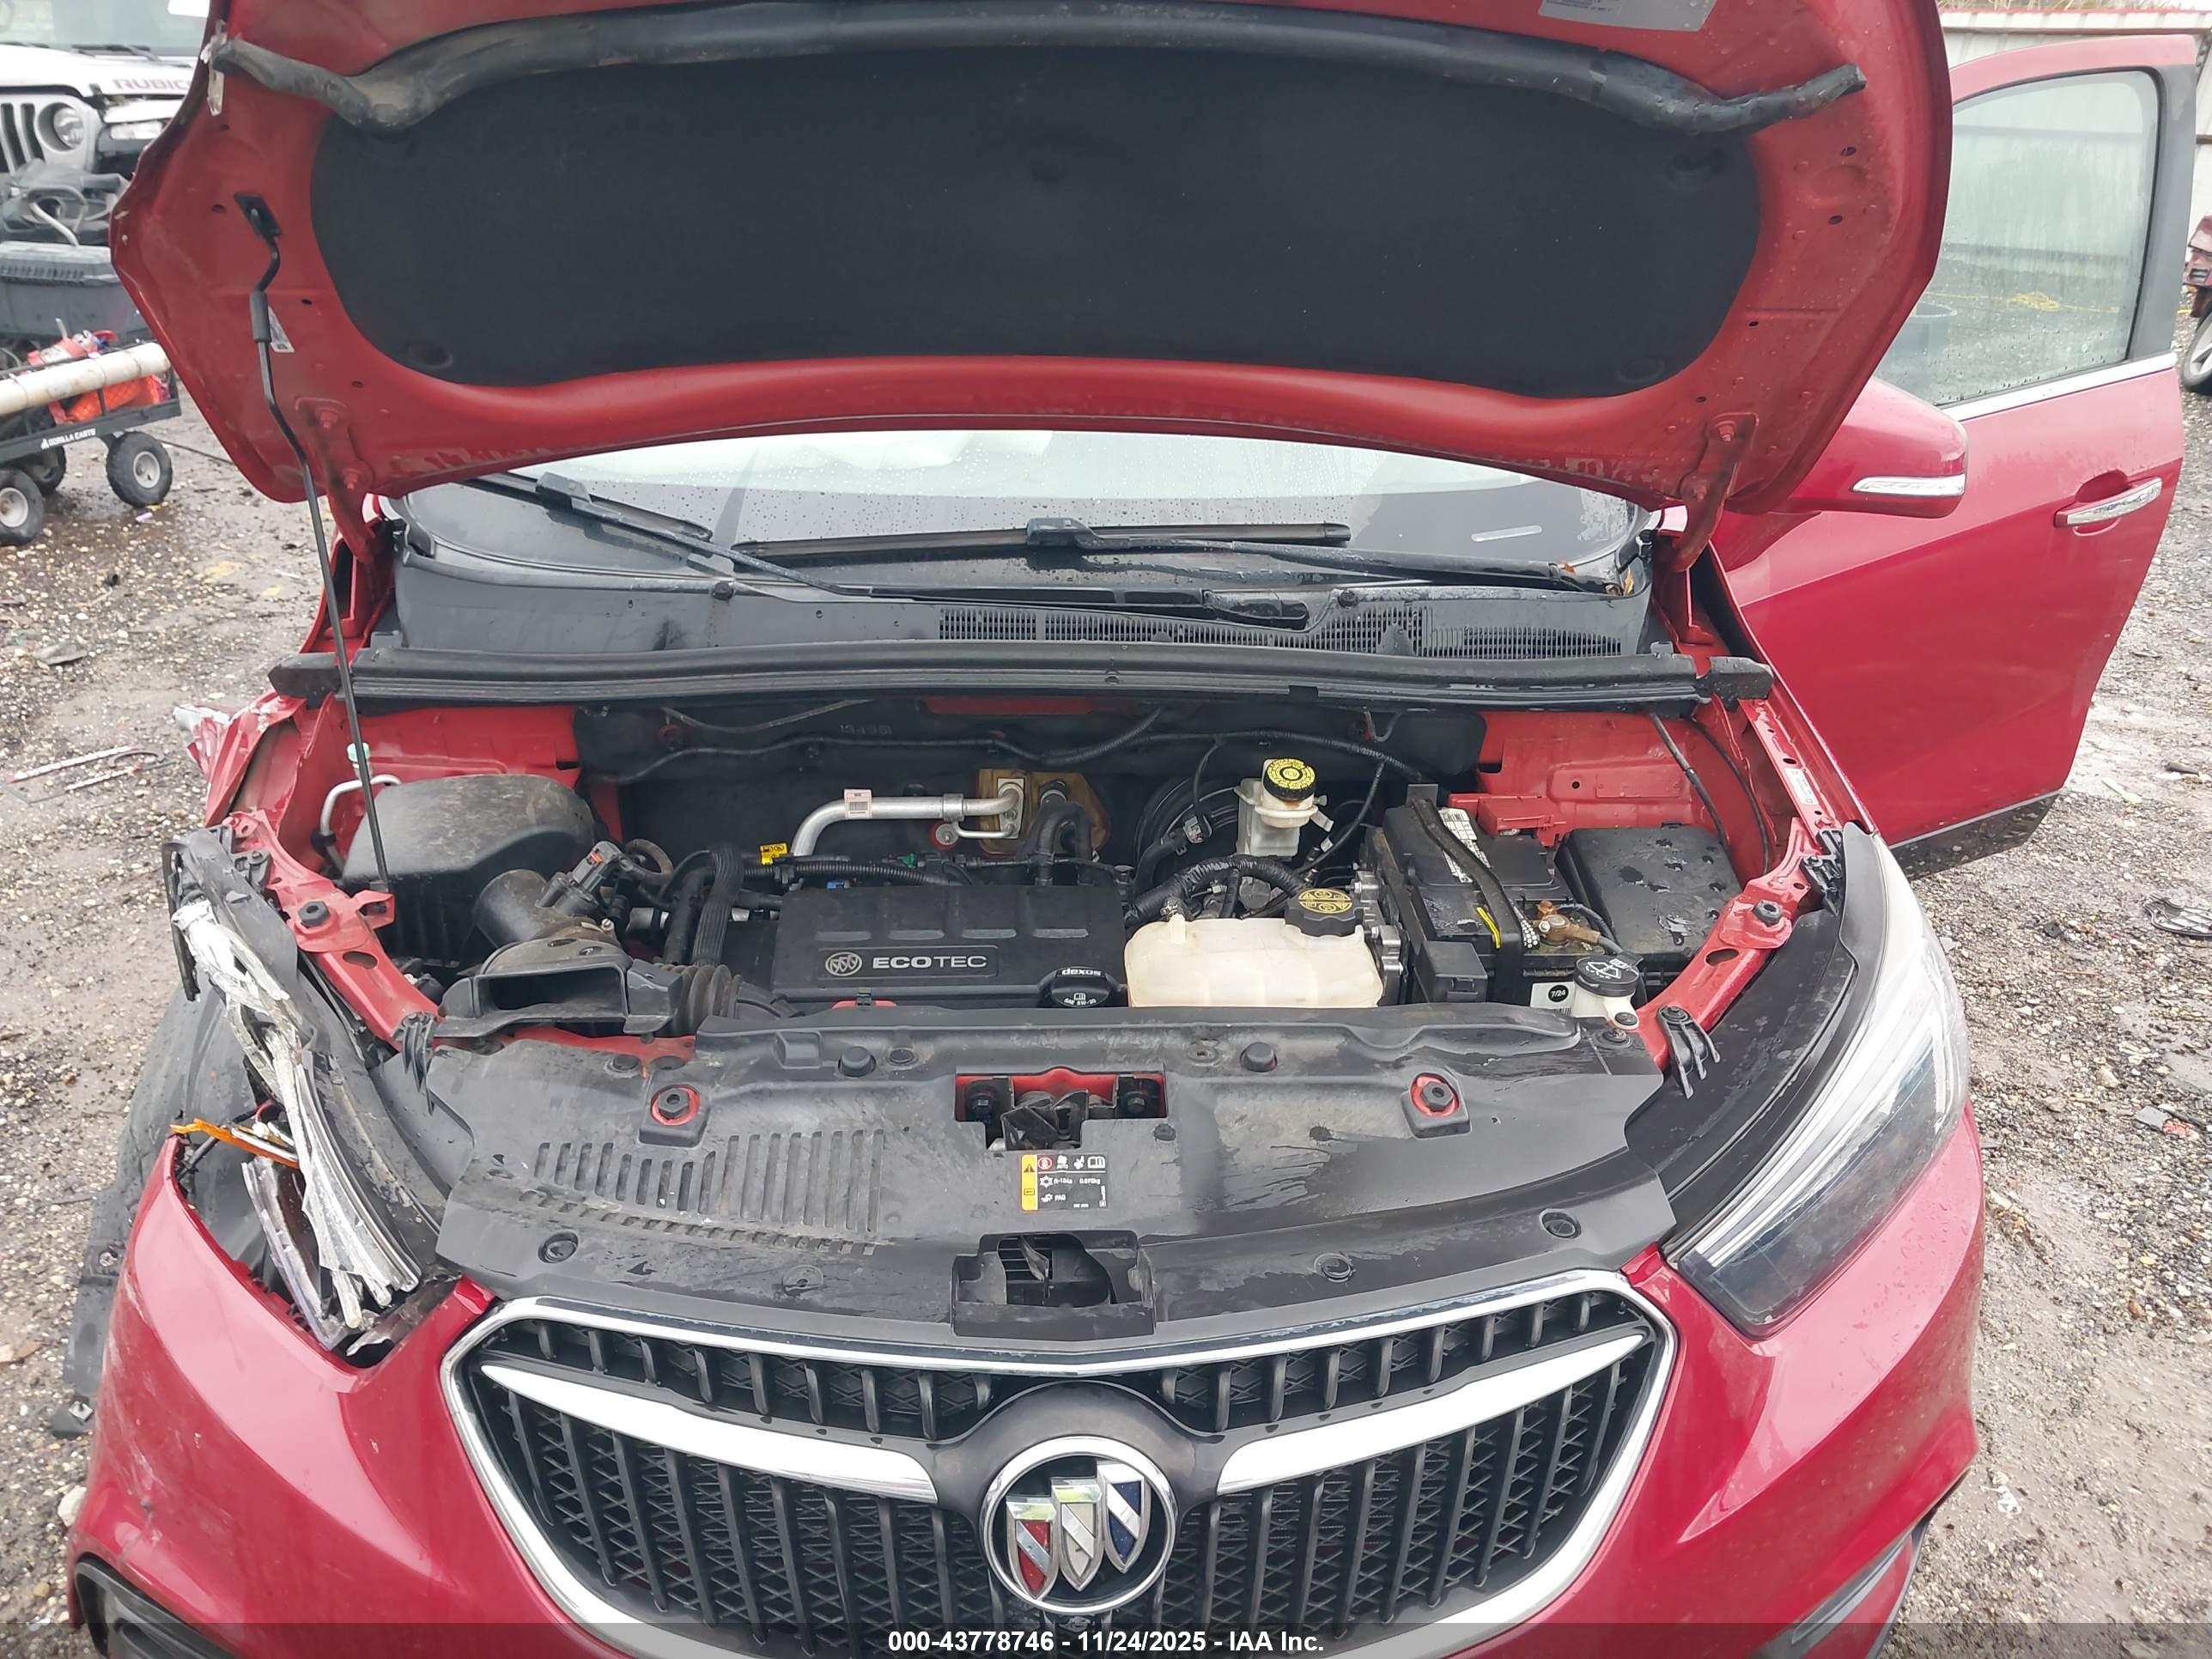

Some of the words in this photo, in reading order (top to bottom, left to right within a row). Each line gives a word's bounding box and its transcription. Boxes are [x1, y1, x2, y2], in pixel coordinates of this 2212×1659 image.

[112, 78, 191, 90] RUBIC
[872, 955, 988, 969] ECOTEC
[1551, 989, 1566, 999] 7/24
